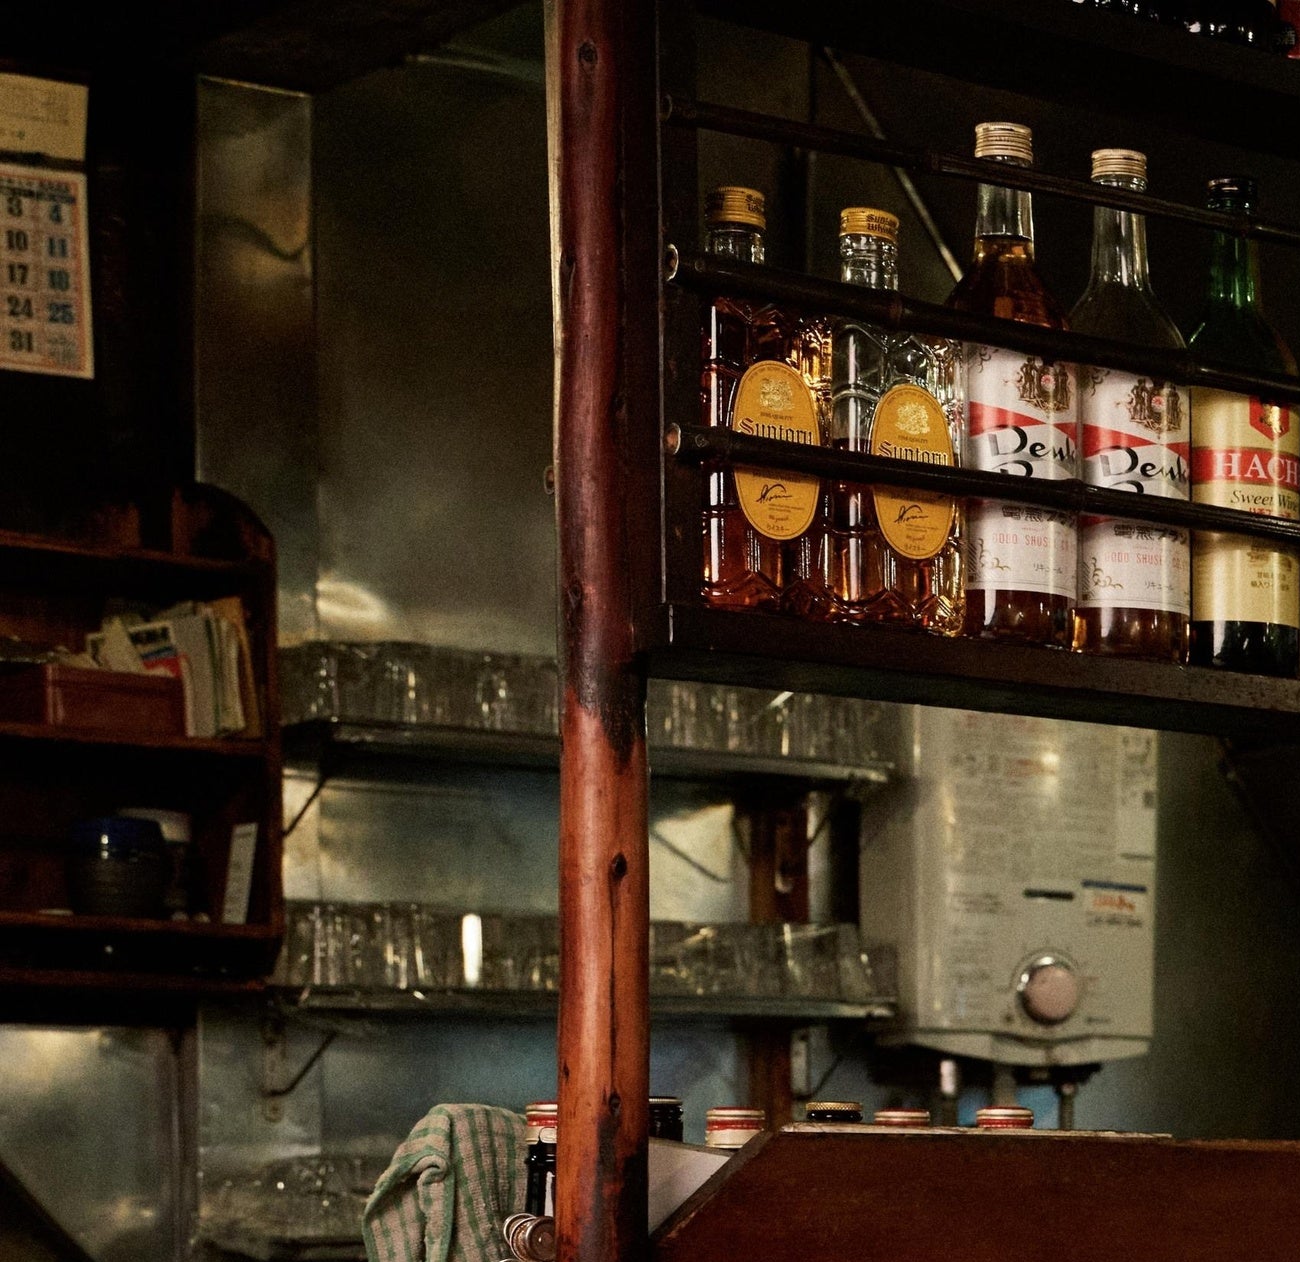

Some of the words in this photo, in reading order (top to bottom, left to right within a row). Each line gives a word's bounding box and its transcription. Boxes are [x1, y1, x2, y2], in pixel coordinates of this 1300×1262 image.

[6, 198, 23, 217] 3
[51, 205, 63, 225] 4
[6, 230, 28, 251] 10
[48, 238, 67, 258] 11
[8, 264, 28, 285] 17
[48, 270, 70, 291] 18
[8, 297, 32, 318] 24
[48, 303, 73, 324] 25
[10, 331, 32, 352] 31
[1213, 452, 1299, 486] HACH
